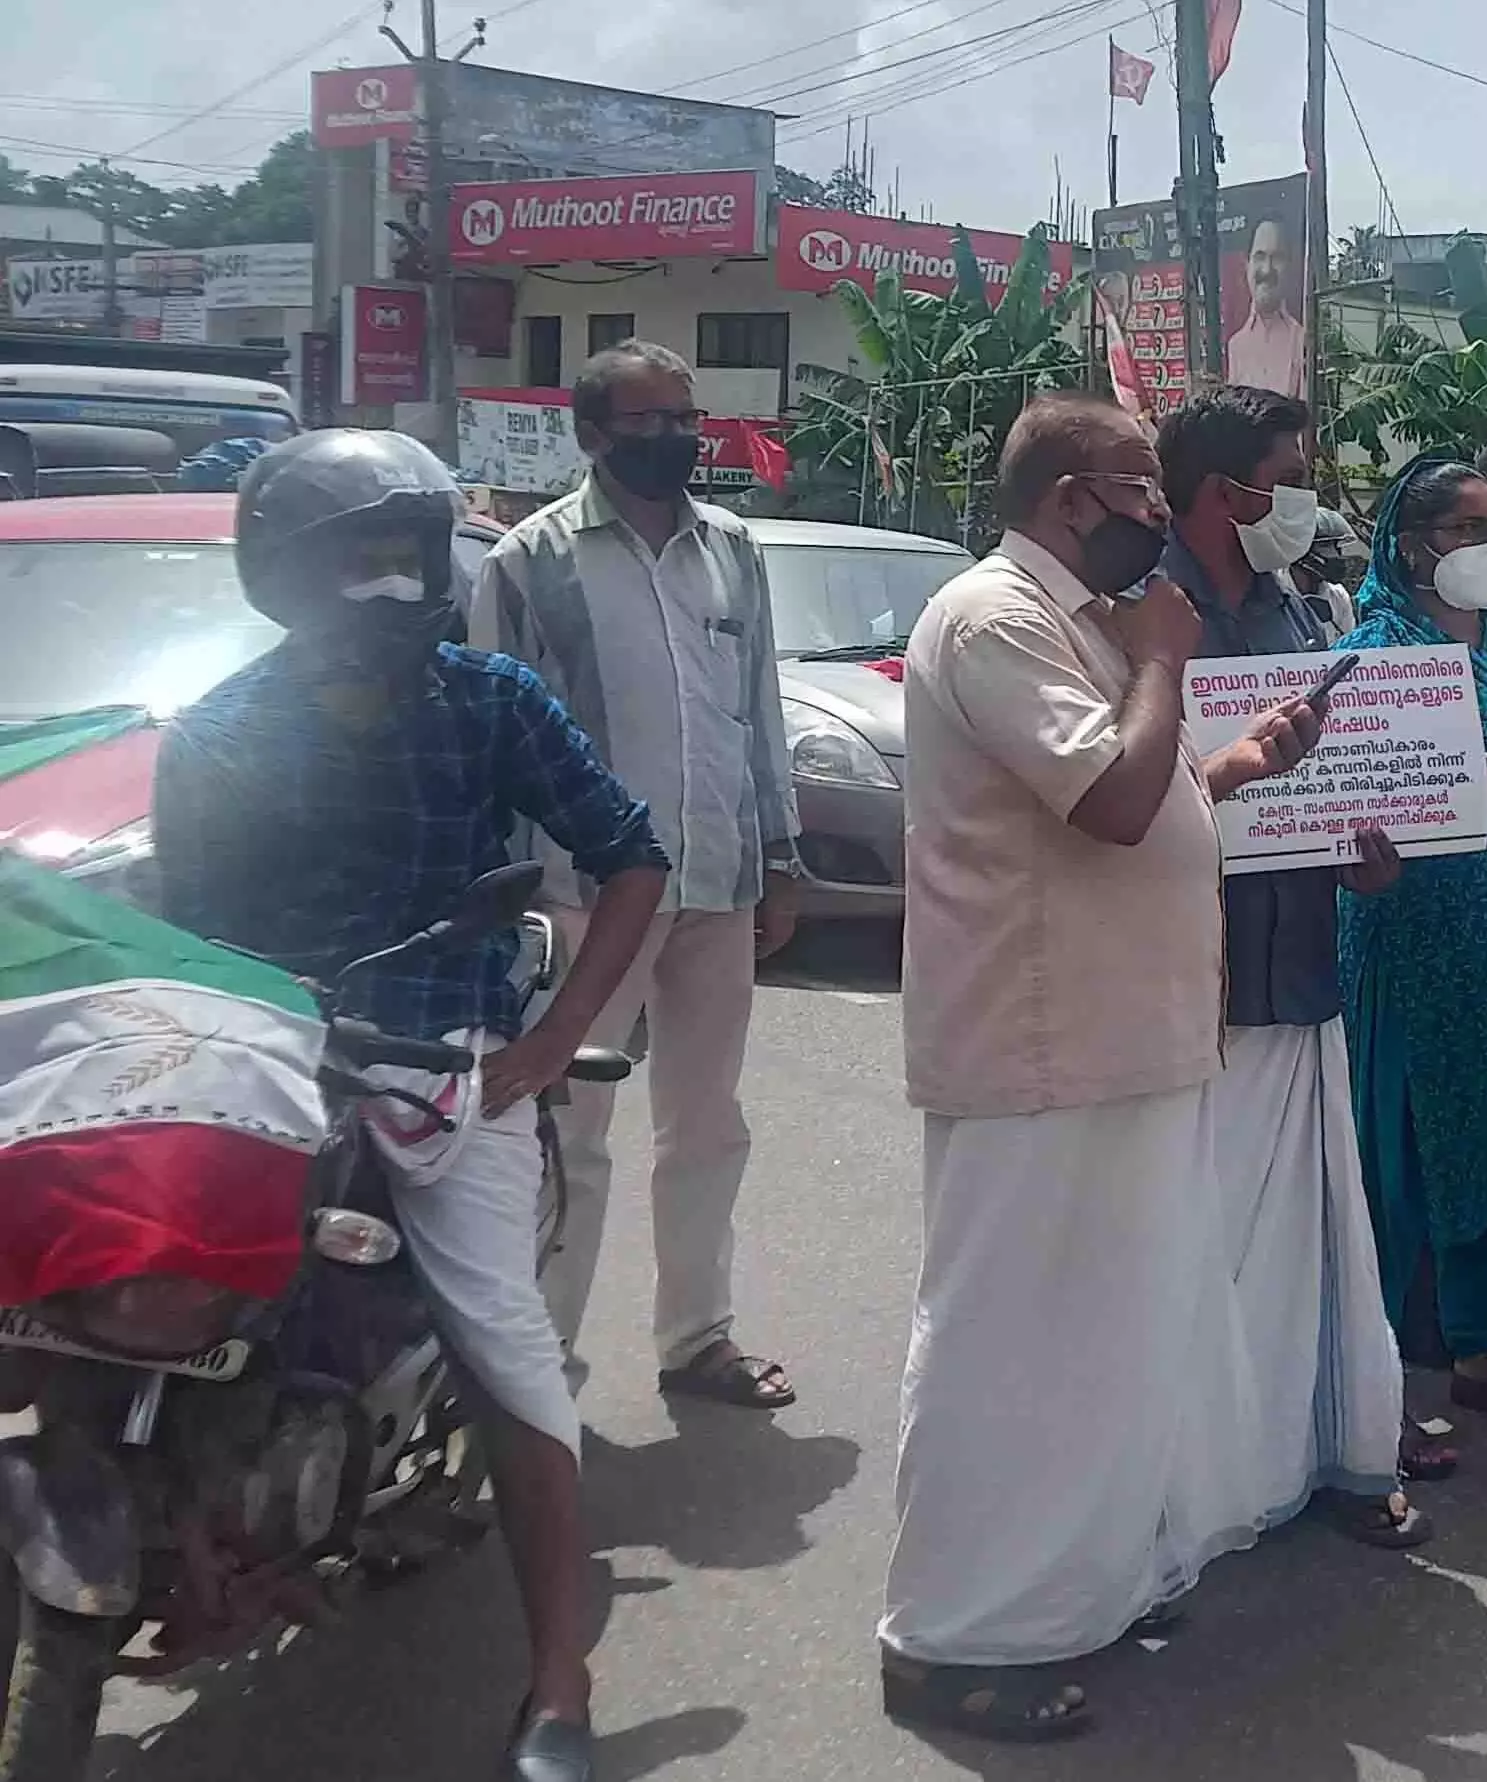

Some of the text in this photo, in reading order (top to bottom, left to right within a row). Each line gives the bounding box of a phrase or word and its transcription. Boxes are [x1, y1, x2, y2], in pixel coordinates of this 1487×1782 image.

[511, 191, 736, 229] Muthoot Finance
[856, 243, 958, 280] Muthoo
[711, 470, 753, 482] AKERY
[1190, 673, 1259, 697] ഇന്ധന
[1336, 839, 1361, 858] FIT
